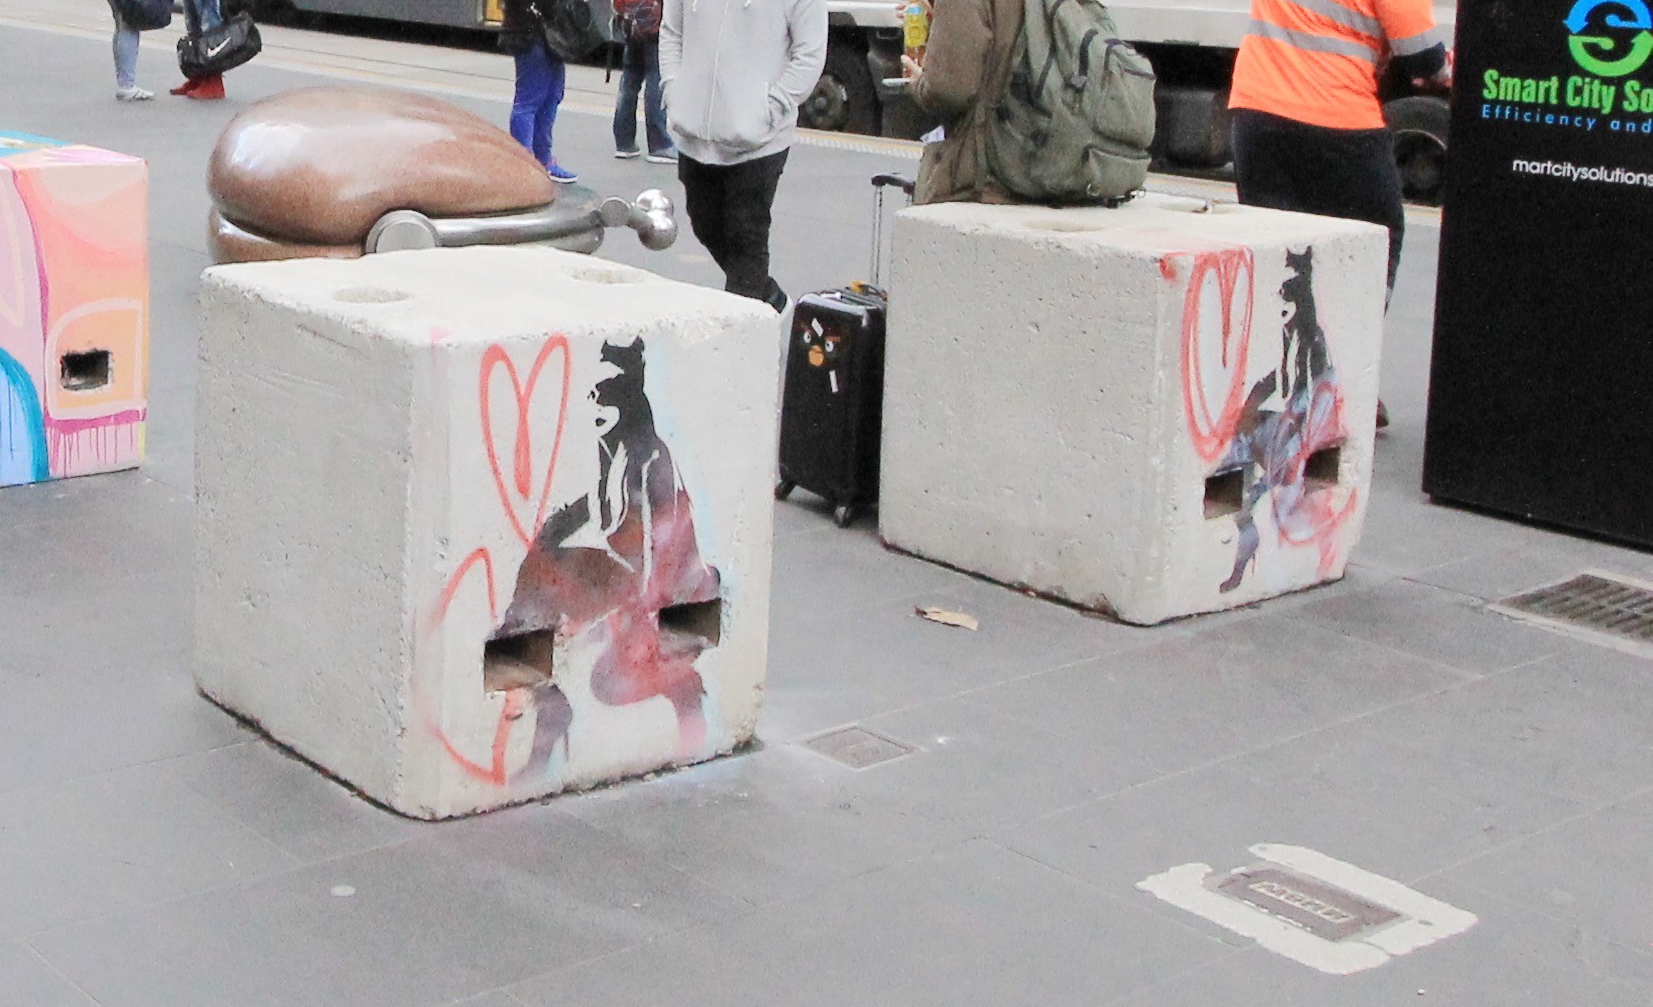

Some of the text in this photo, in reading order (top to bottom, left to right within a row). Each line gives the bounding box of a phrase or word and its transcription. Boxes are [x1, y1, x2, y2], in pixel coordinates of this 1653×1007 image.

[1482, 69, 1653, 114] Smart City So
[1482, 104, 1653, 133] Efficiency and
